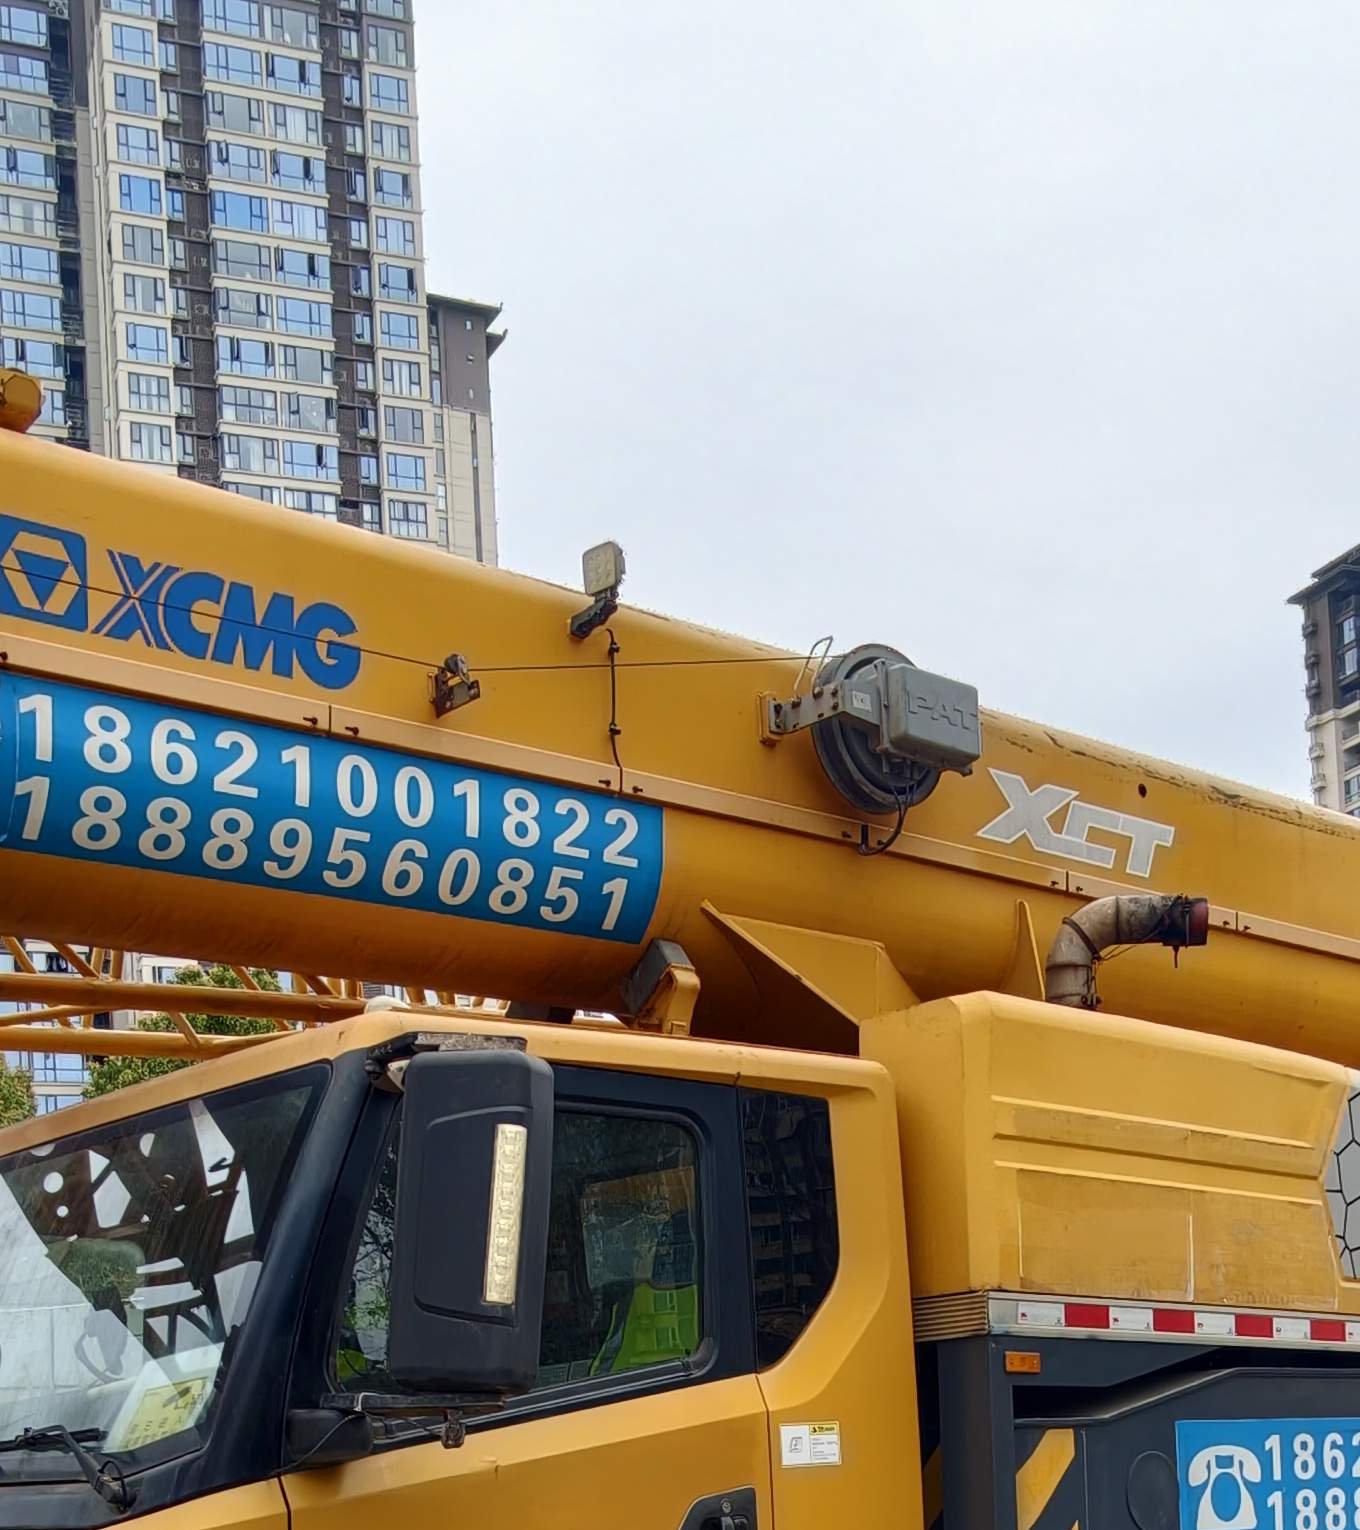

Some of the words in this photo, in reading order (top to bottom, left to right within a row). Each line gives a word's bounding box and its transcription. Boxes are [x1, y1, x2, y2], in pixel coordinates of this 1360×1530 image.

[90, 549, 361, 690] XCMG
[14, 776, 628, 931] 18889560851
[18, 694, 639, 869] 18621001822
[976, 767, 1175, 878] XCT
